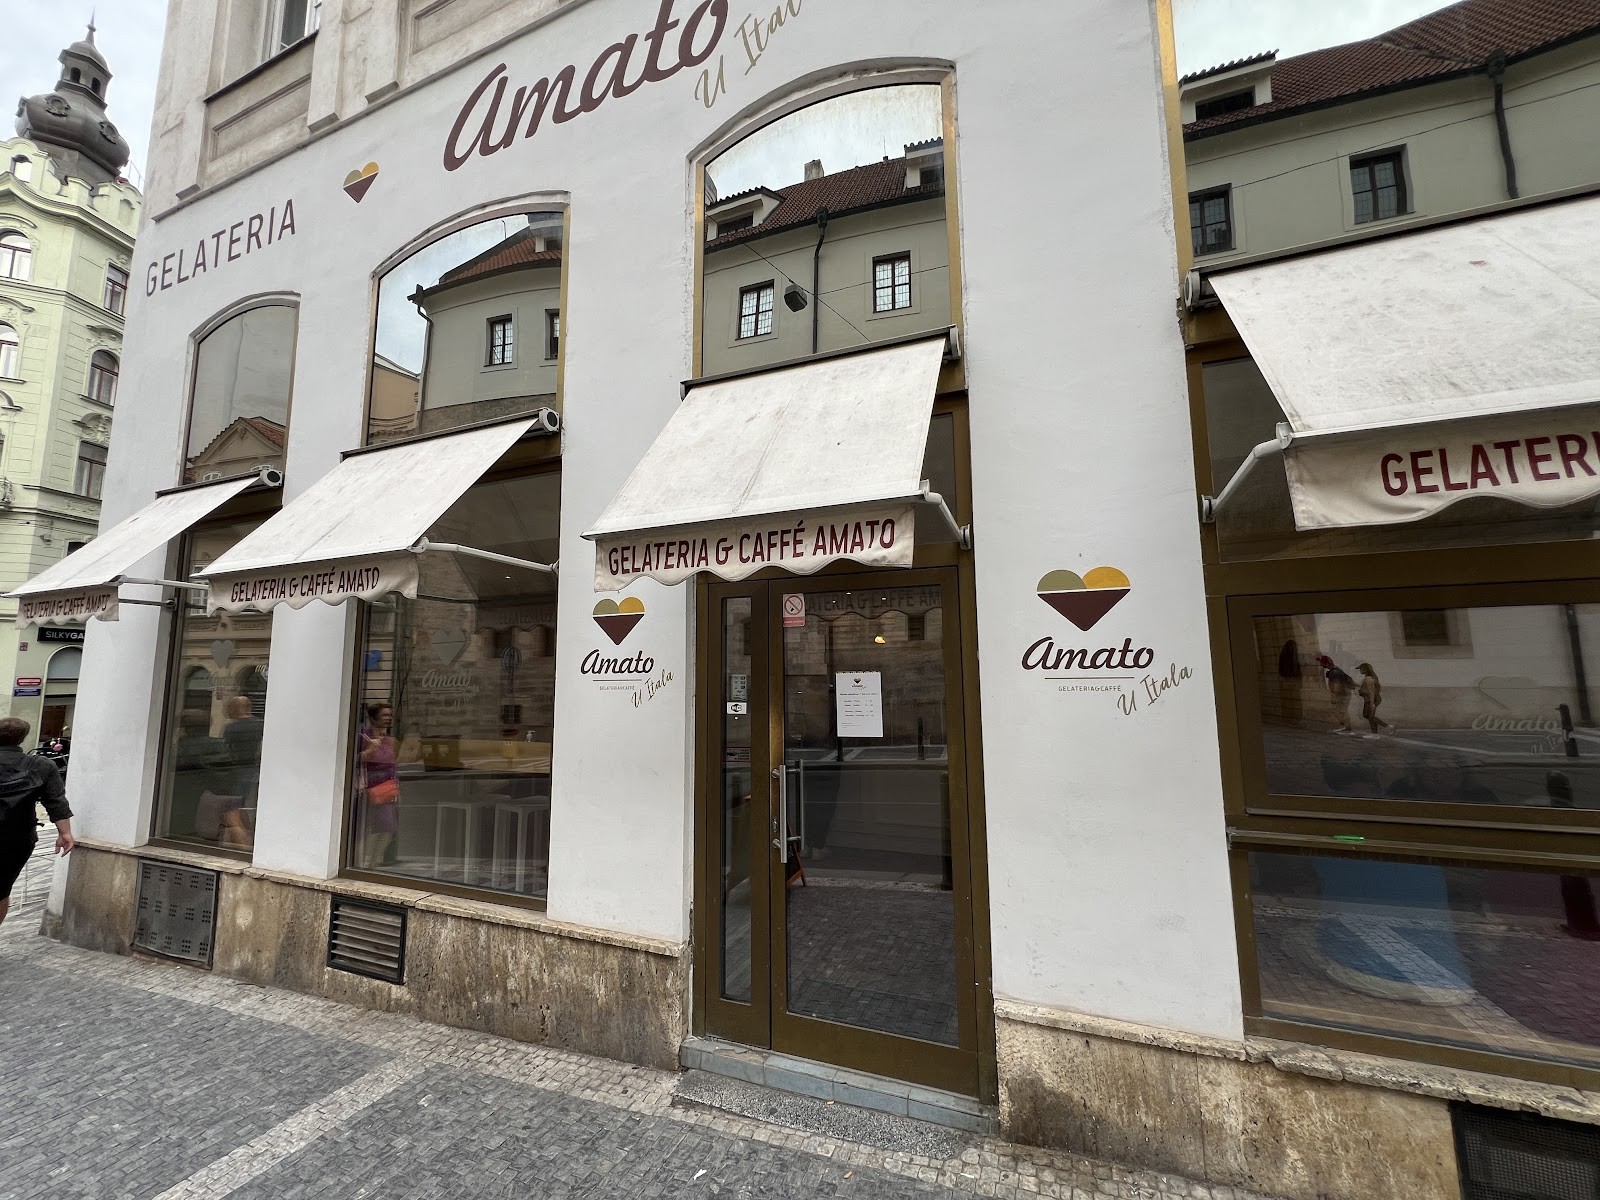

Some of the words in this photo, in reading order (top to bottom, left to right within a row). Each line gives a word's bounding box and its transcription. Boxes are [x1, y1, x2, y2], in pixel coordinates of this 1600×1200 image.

[443, 0, 729, 172] Amato
[695, 55, 726, 109] U
[146, 198, 296, 298] GELATERIA
[608, 538, 709, 576] GELATERIA
[739, 519, 805, 564] CAFFÉ
[812, 518, 896, 556] AMATO
[230, 577, 286, 602] GELATERIA
[300, 566, 336, 597] CAFFÉ
[337, 566, 380, 593] AMATO
[580, 648, 655, 675] Amato
[1021, 636, 1154, 671] Amato
[631, 689, 643, 708] U
[644, 669, 675, 701] Itala
[1117, 690, 1137, 716] U
[1139, 662, 1193, 707] Itala
